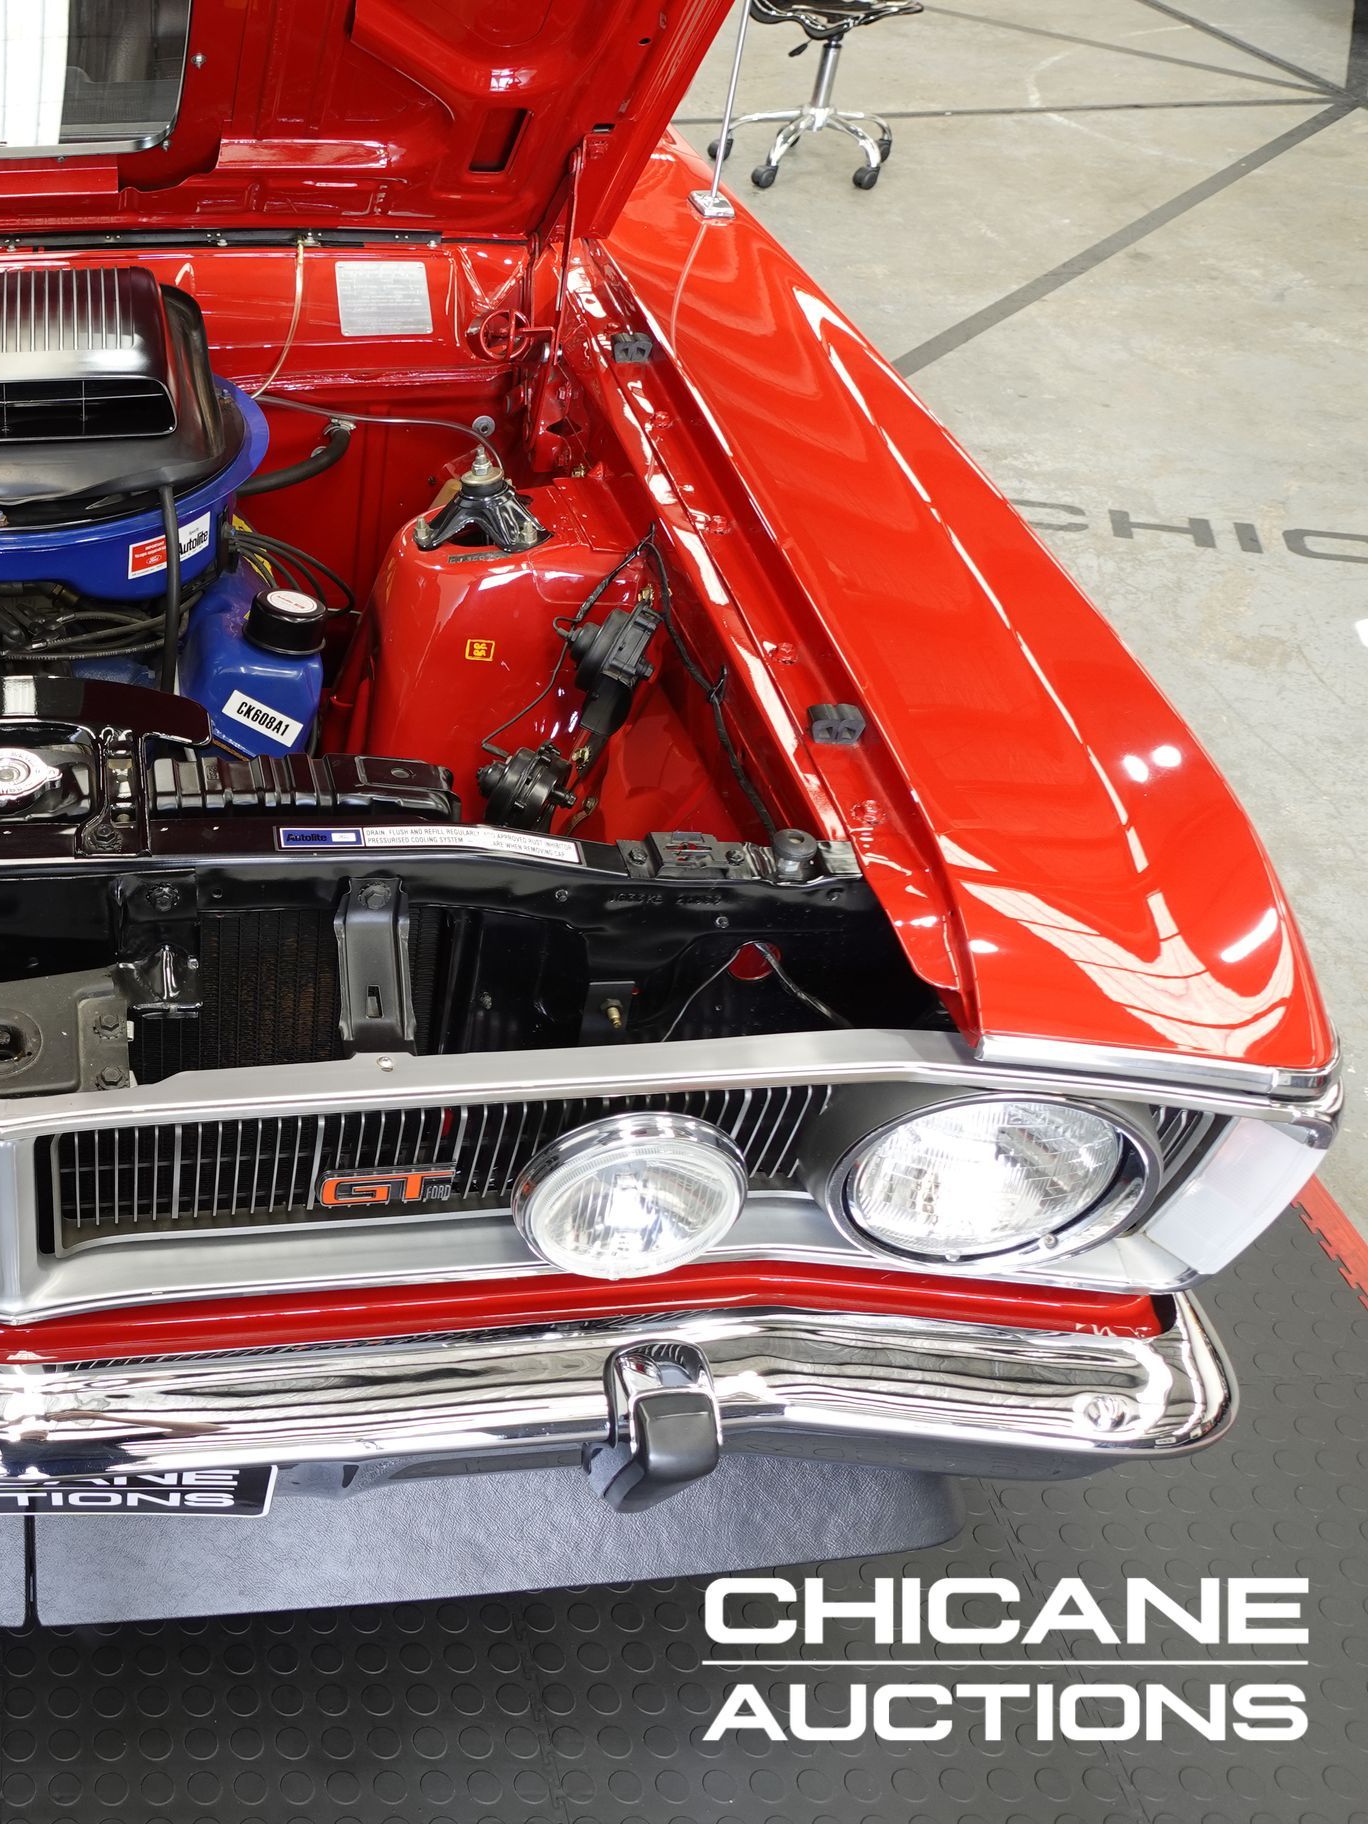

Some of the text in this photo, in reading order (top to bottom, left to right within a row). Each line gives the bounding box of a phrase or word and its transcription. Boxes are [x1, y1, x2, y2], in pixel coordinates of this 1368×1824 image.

[178, 530, 209, 555] Autolite
[236, 701, 290, 737] CK608A1
[286, 833, 328, 842] Autolite
[367, 836, 409, 844] PRESSURISED
[319, 1169, 457, 1208] GT FORD
